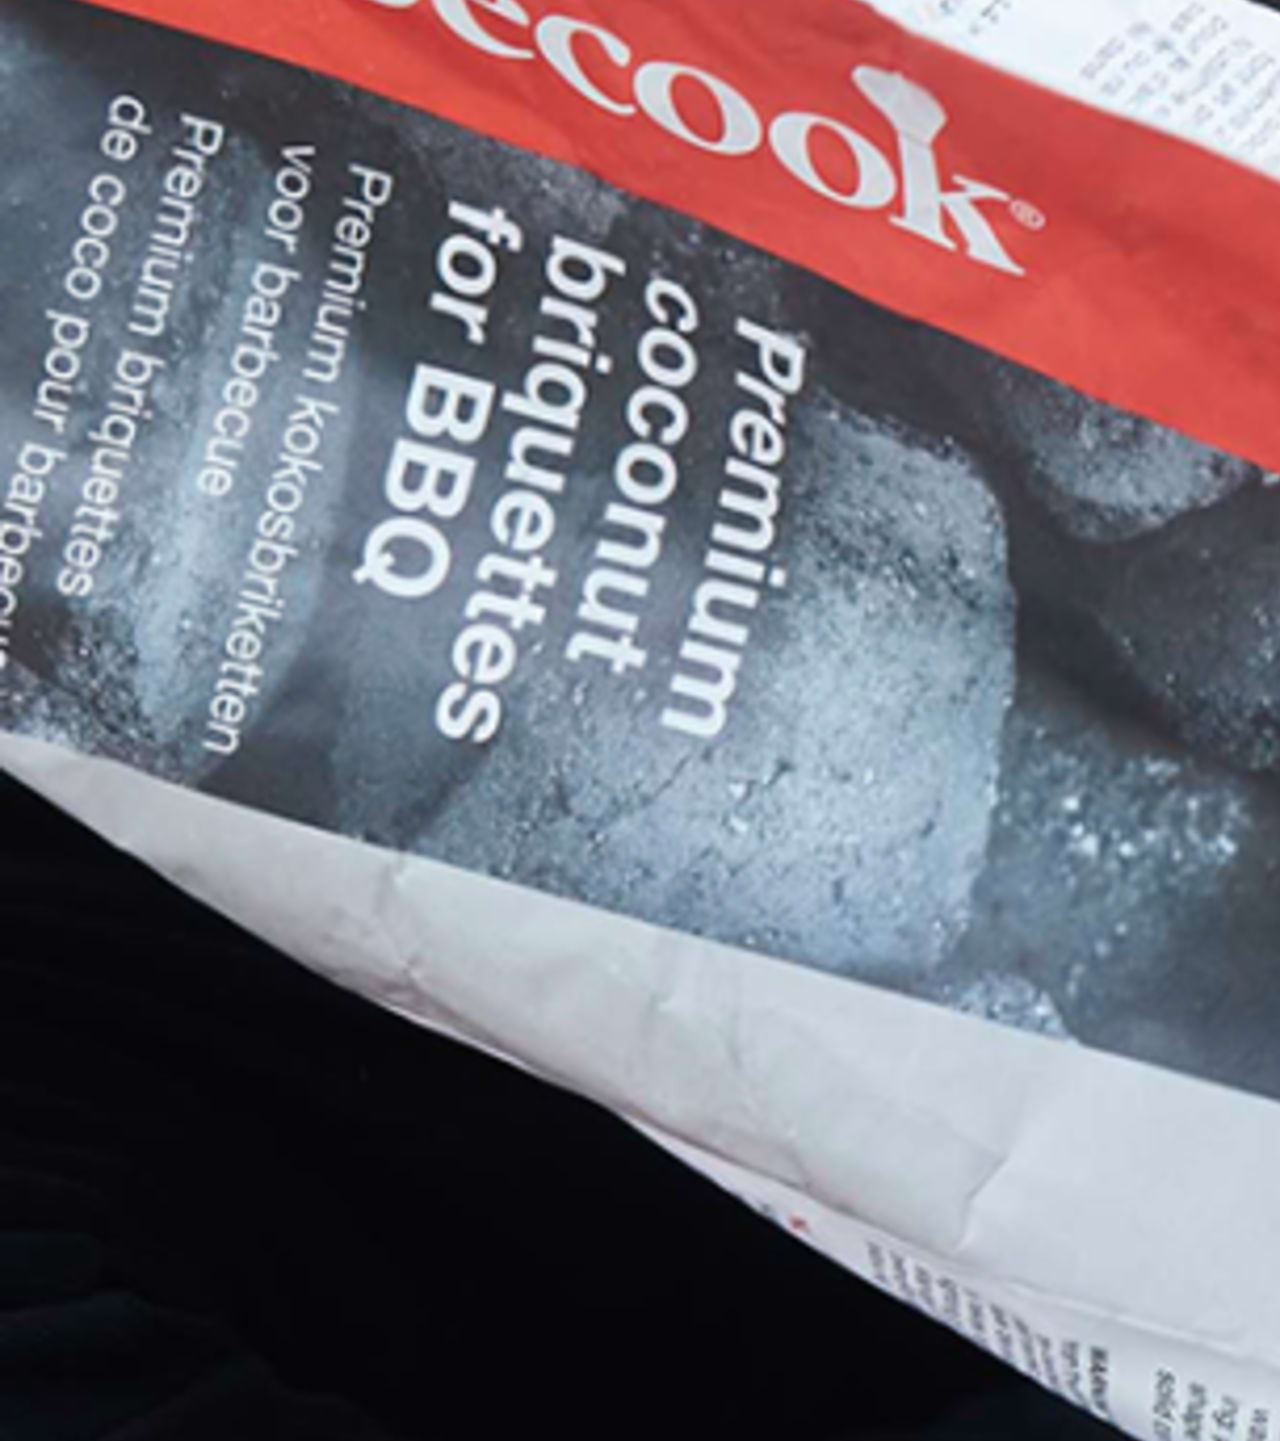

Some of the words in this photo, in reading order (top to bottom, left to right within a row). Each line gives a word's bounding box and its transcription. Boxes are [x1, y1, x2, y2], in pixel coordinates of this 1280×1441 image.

[64, 170, 128, 302] coco
[99, 94, 153, 163] de
[128, 112, 225, 340] Premium
[266, 144, 316, 256] voor
[33, 307, 92, 437] pour
[198, 260, 300, 498] barbecue
[300, 161, 393, 385] Premium
[430, 199, 524, 347] for
[0, 442, 68, 668] barbe
[57, 350, 167, 600] briquettes
[202, 396, 343, 756] kokosbriketten
[352, 363, 496, 602] BBQ
[434, 234, 626, 746] briquettes
[566, 276, 700, 675] coconut
[660, 316, 807, 740] Premium
